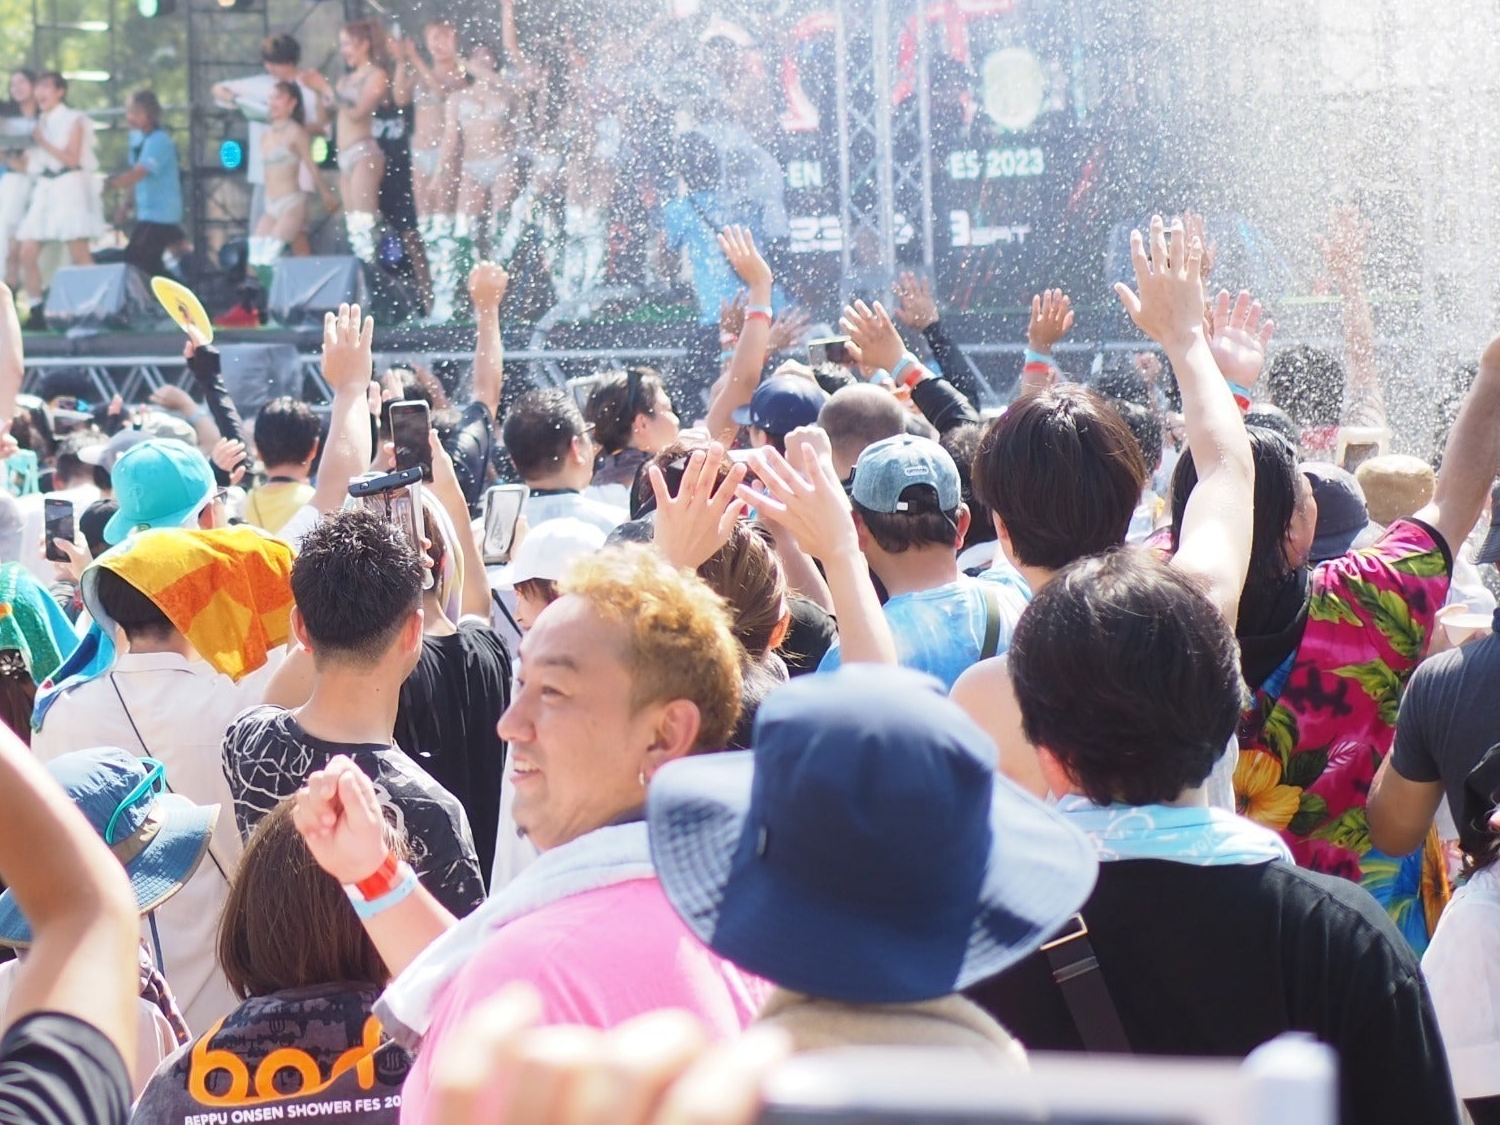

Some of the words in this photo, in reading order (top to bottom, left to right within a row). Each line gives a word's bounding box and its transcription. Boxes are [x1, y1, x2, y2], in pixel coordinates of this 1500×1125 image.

[950, 149, 980, 179] ES
[985, 147, 1045, 178] 2023
[184, 1112, 228, 1125] BEPPU
[231, 1107, 284, 1123] ONSEN
[288, 1100, 352, 1117] SHOWER
[355, 1097, 381, 1112] FES
[384, 1095, 402, 1108] 20
